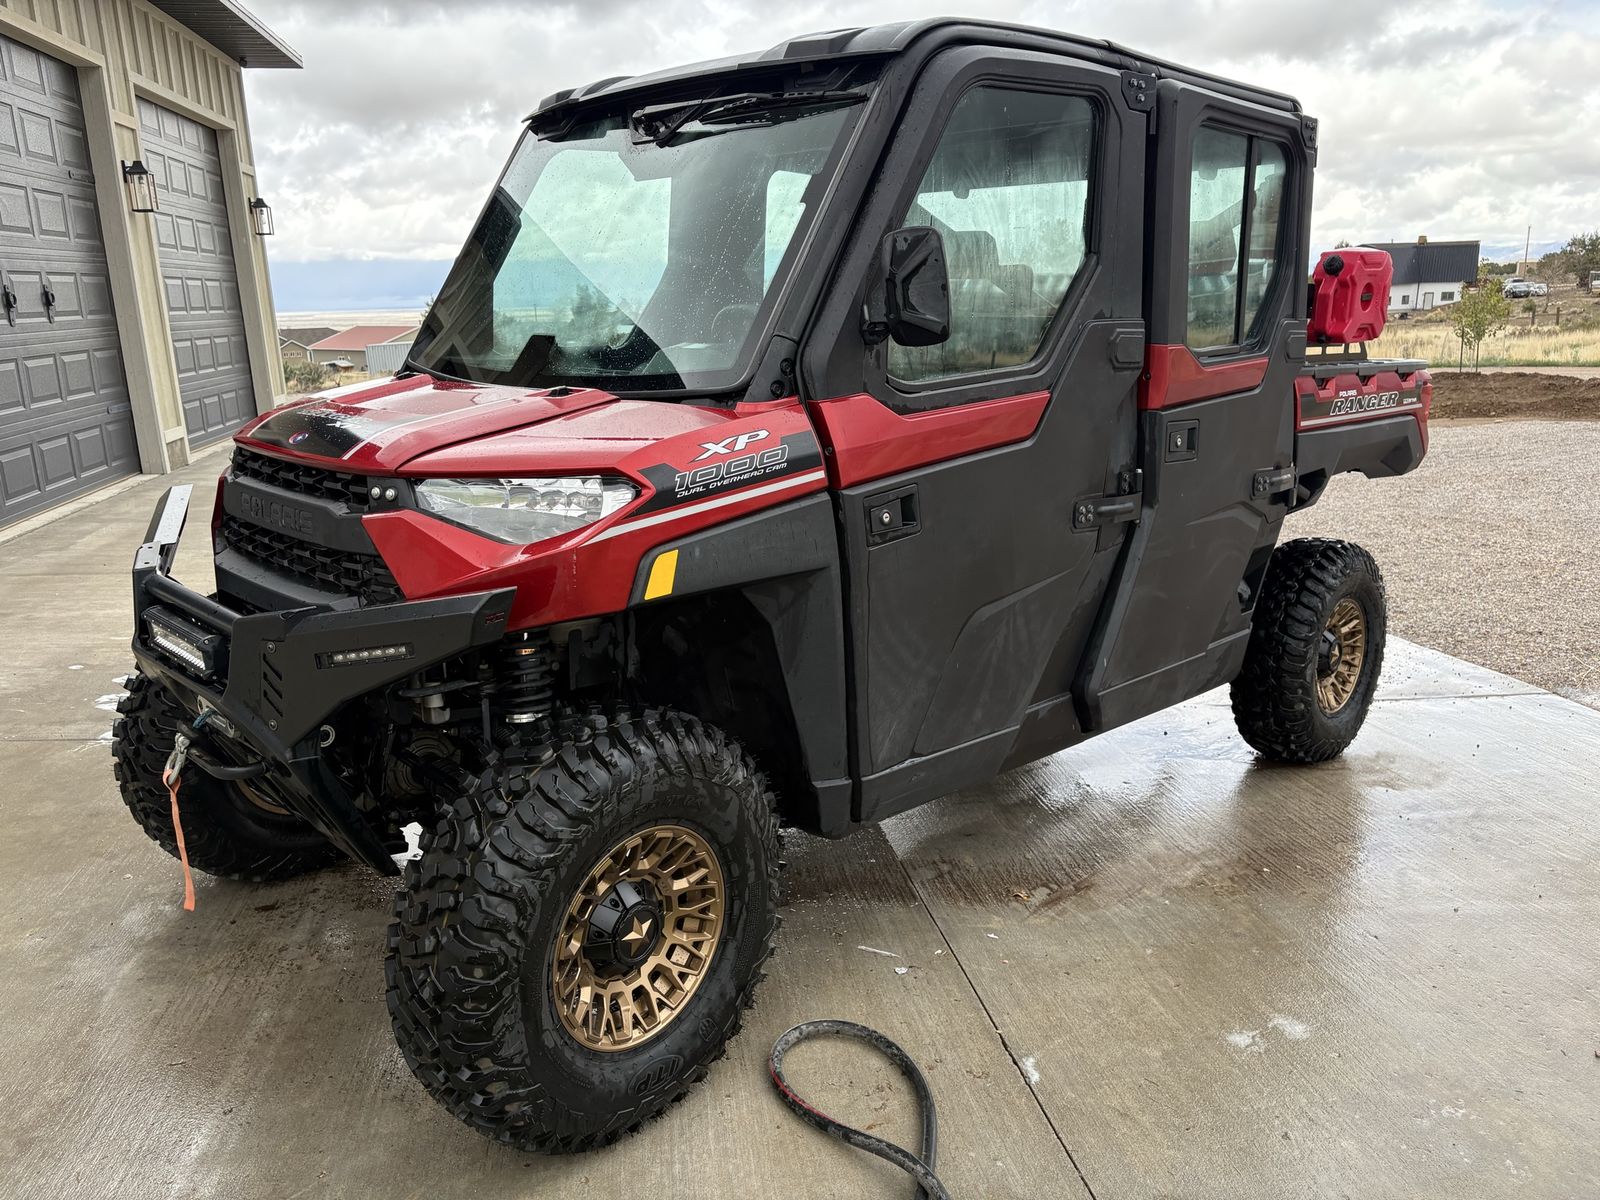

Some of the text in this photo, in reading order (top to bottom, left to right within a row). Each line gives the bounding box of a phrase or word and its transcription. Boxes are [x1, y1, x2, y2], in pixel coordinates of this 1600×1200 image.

[1330, 391, 1399, 416] RANGER
[690, 429, 770, 462] XP
[675, 445, 788, 491] 1000
[677, 462, 788, 498] DUAL OVERHEAD CAM
